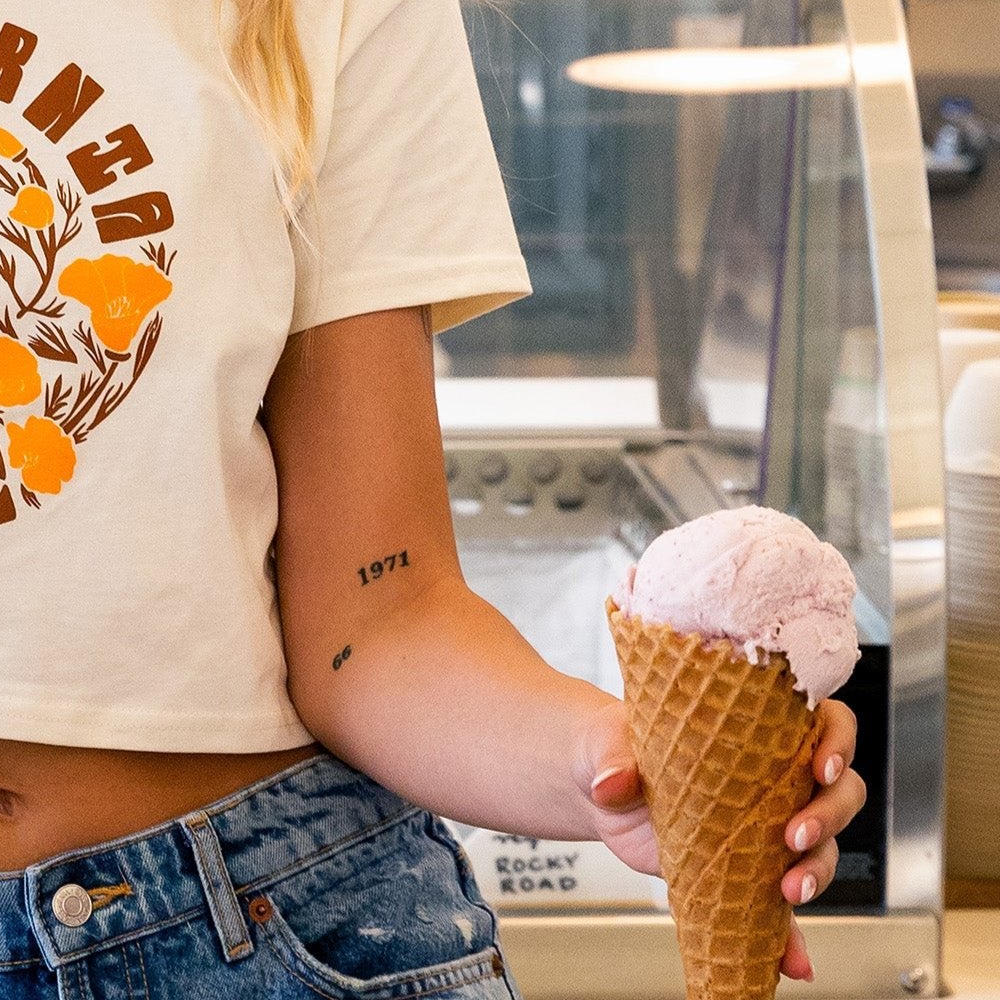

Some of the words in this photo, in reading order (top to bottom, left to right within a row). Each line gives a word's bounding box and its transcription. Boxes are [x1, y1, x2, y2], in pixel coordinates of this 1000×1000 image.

[357, 549, 410, 587] 1971
[495, 852, 580, 874] ROCKY
[499, 875, 577, 893] ROAD
